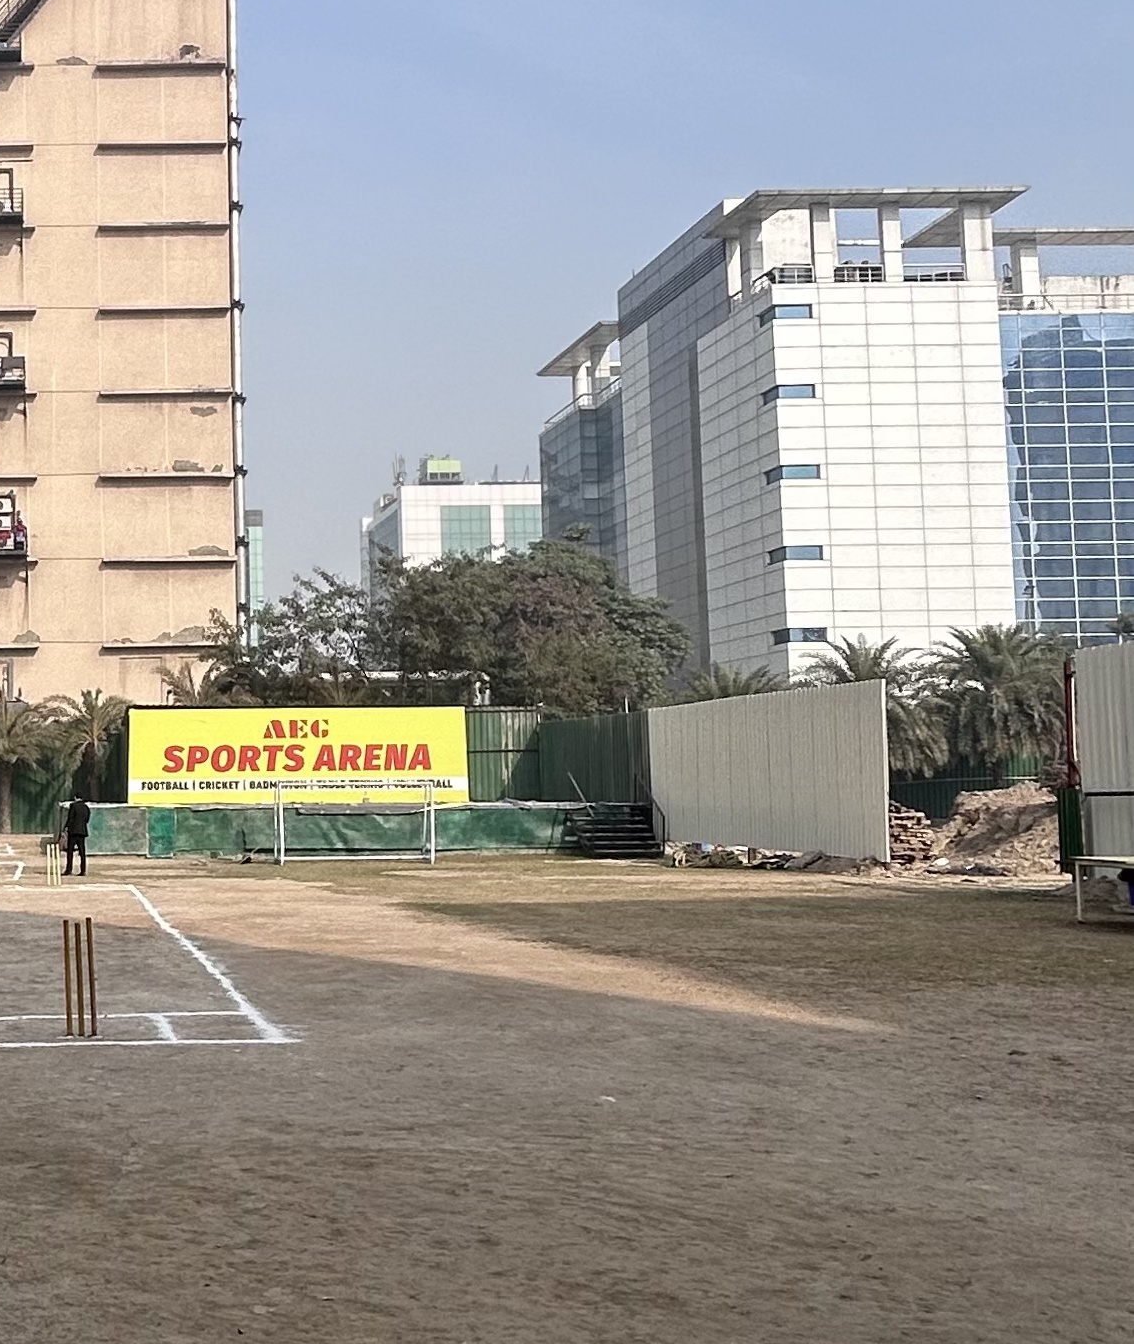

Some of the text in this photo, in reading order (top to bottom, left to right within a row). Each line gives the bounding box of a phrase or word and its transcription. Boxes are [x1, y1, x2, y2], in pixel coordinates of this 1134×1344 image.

[263, 719, 329, 739] AEG
[162, 744, 432, 773] SPORTS ARENA
[140, 781, 190, 791] FOOTBALL
[198, 780, 241, 790] CRICKET
